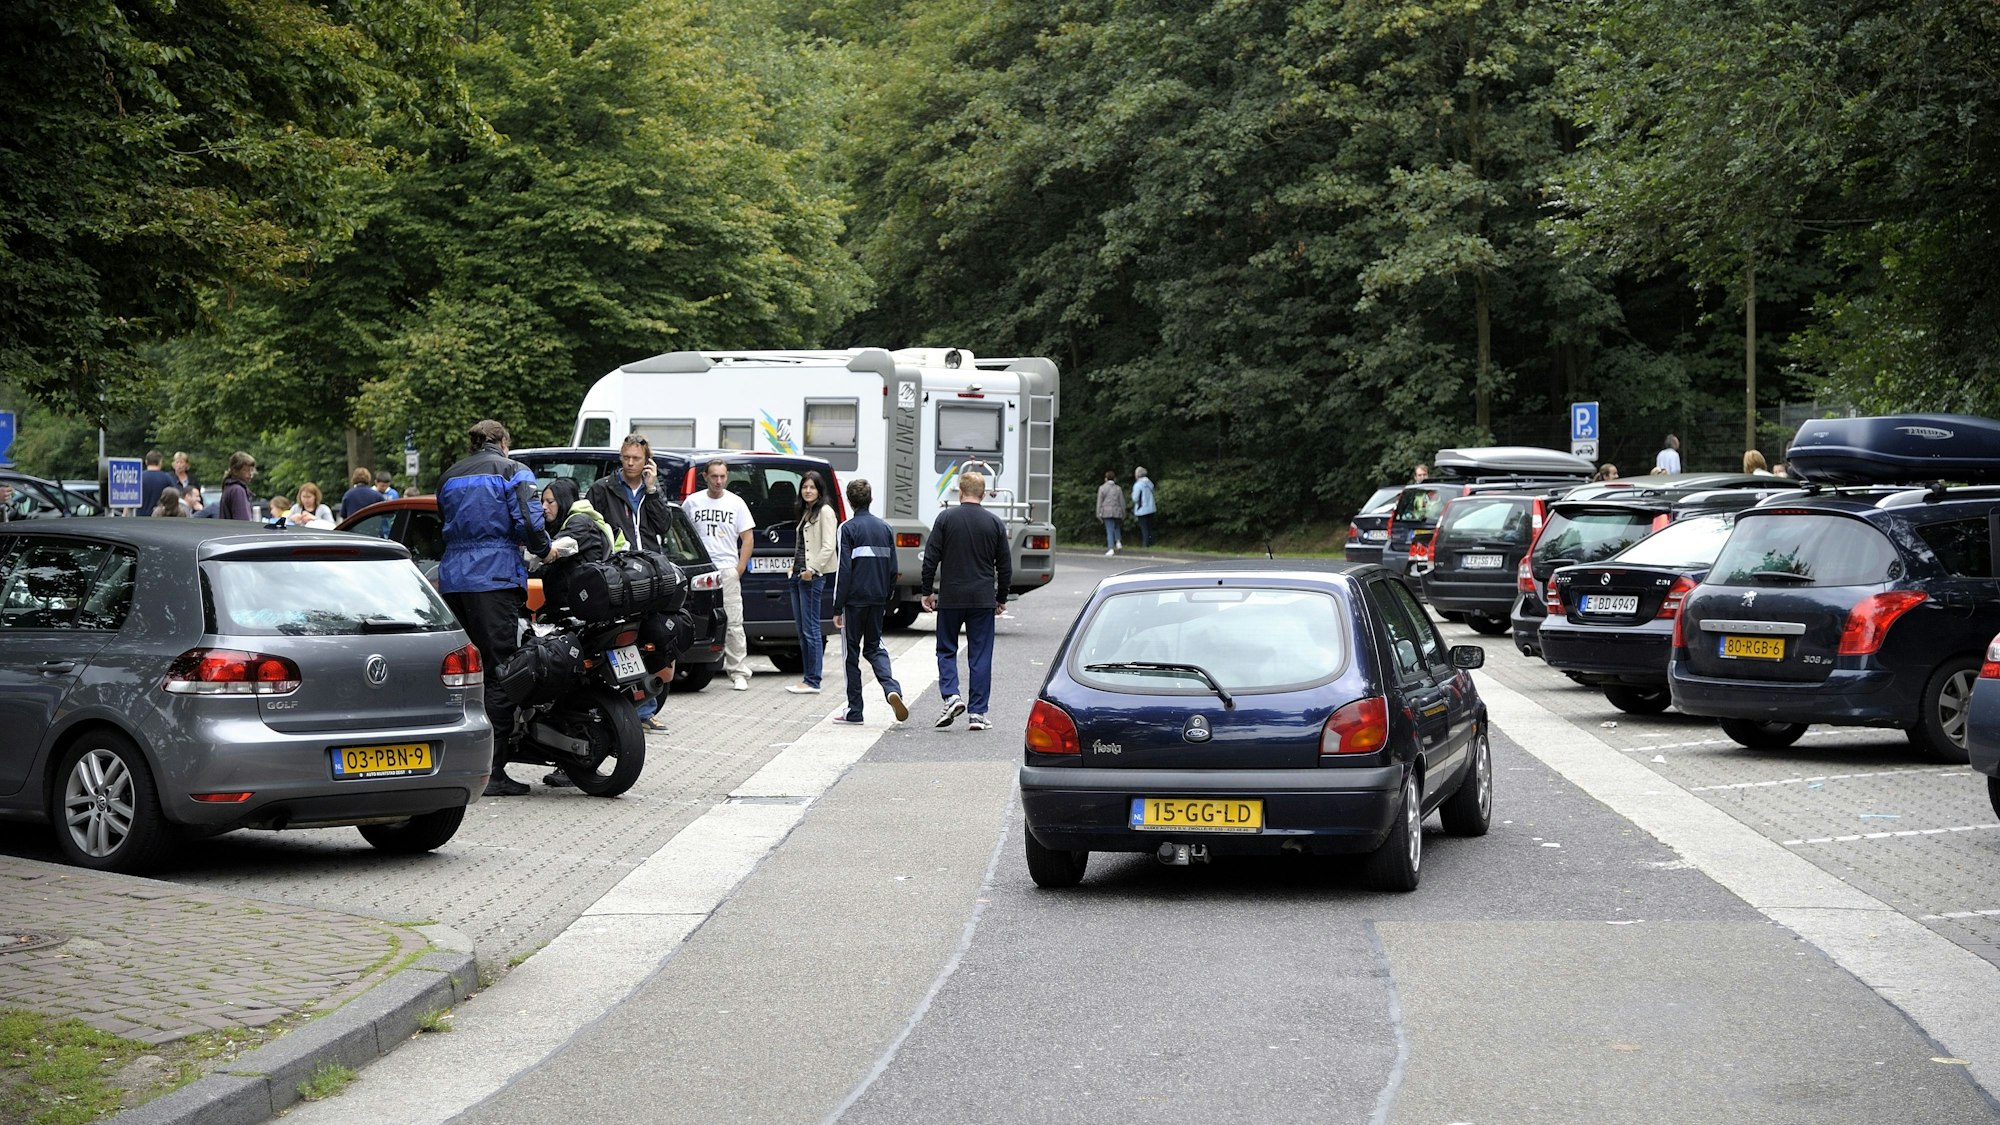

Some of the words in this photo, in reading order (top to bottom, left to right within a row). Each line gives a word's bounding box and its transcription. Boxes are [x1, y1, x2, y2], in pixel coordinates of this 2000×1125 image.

[1576, 407, 1590, 436] P
[894, 406, 915, 515] TRAVEL-LINER
[112, 464, 138, 488] Parkplatz
[694, 509, 734, 524] BELIEVE
[707, 524, 718, 537] IT
[754, 559, 763, 569] IF
[770, 559, 780, 569] AC
[1587, 597, 1593, 609] E
[1598, 597, 1611, 610] BD
[1612, 598, 1636, 611] 4949
[1727, 639, 1780, 656] 80-RGB-6
[617, 650, 630, 662] 1K
[1803, 655, 1821, 664] 308
[615, 660, 640, 677] 7551
[266, 700, 299, 710] GOLF
[347, 747, 424, 769] 03-PBN-9
[1133, 813, 1143, 821] NL
[1153, 802, 1251, 823] 15-GG-LD
